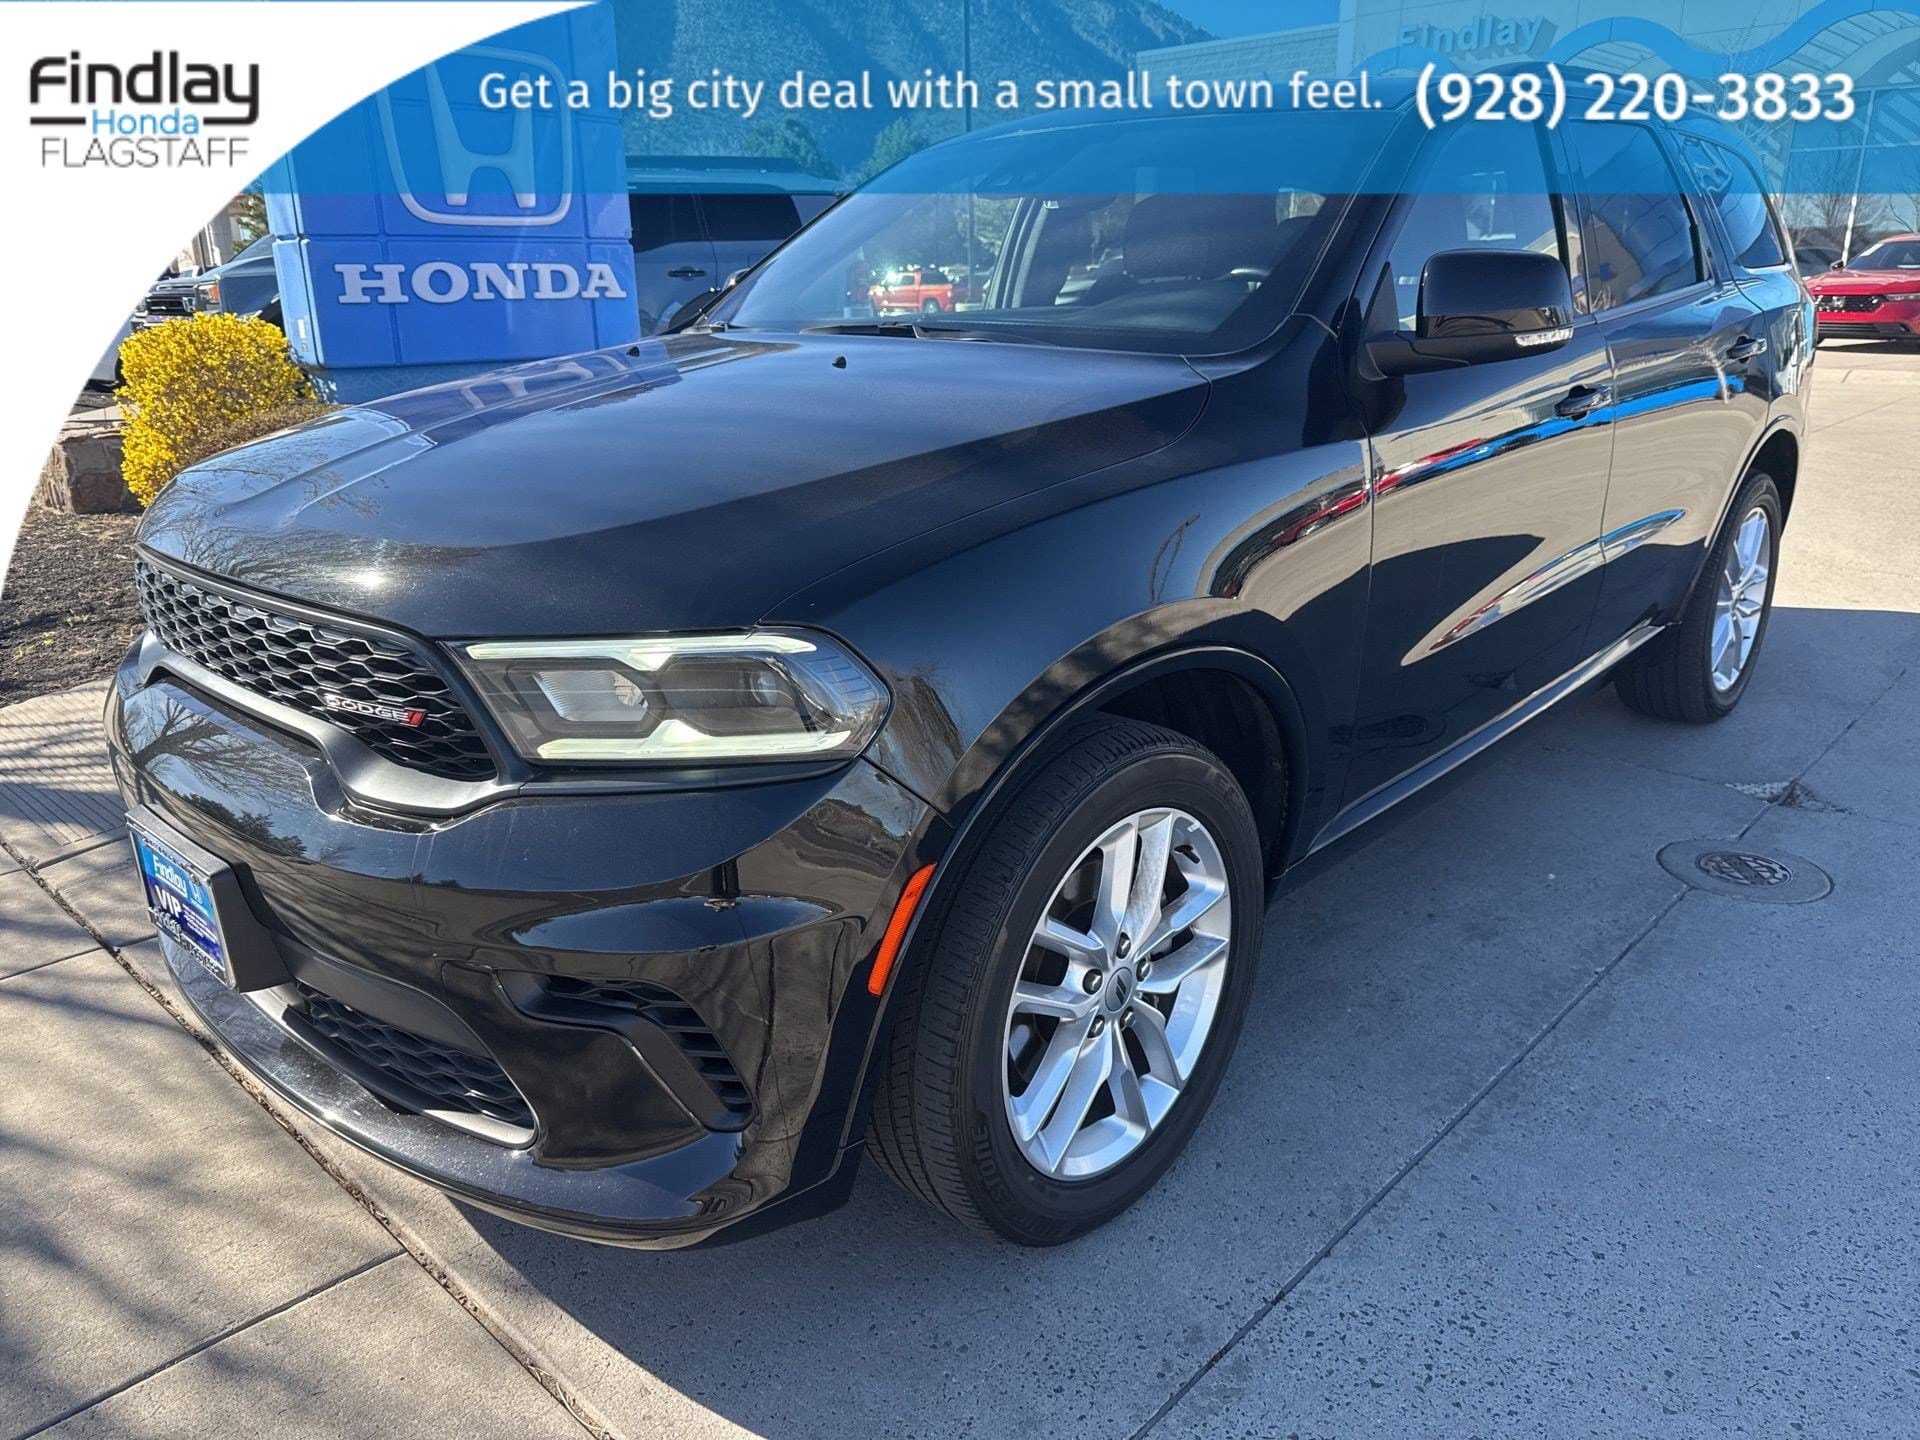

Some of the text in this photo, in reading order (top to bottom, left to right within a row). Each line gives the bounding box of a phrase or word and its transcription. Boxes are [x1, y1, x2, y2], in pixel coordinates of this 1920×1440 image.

[1398, 14, 1545, 52] Findlay
[334, 262, 627, 304] HONDA
[324, 693, 409, 722] DODGE
[154, 884, 182, 918] VIP
